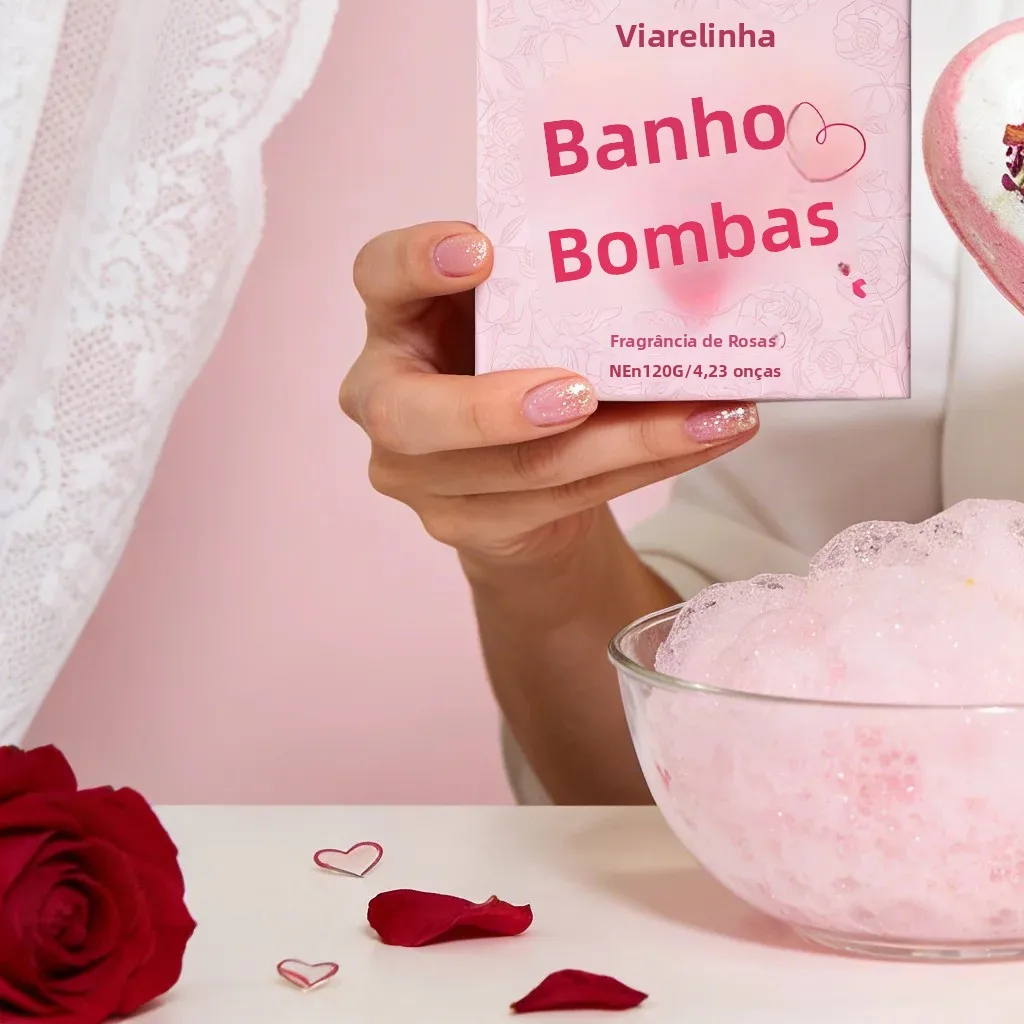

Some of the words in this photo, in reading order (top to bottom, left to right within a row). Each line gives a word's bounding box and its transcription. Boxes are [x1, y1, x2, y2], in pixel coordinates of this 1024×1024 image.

[616, 22, 776, 48] Viarelinha
[543, 96, 786, 178] Banho
[548, 201, 839, 284] Bombas
[610, 333, 697, 351] Fragrância
[702, 333, 723, 348] de
[733, 367, 782, 380] onças
